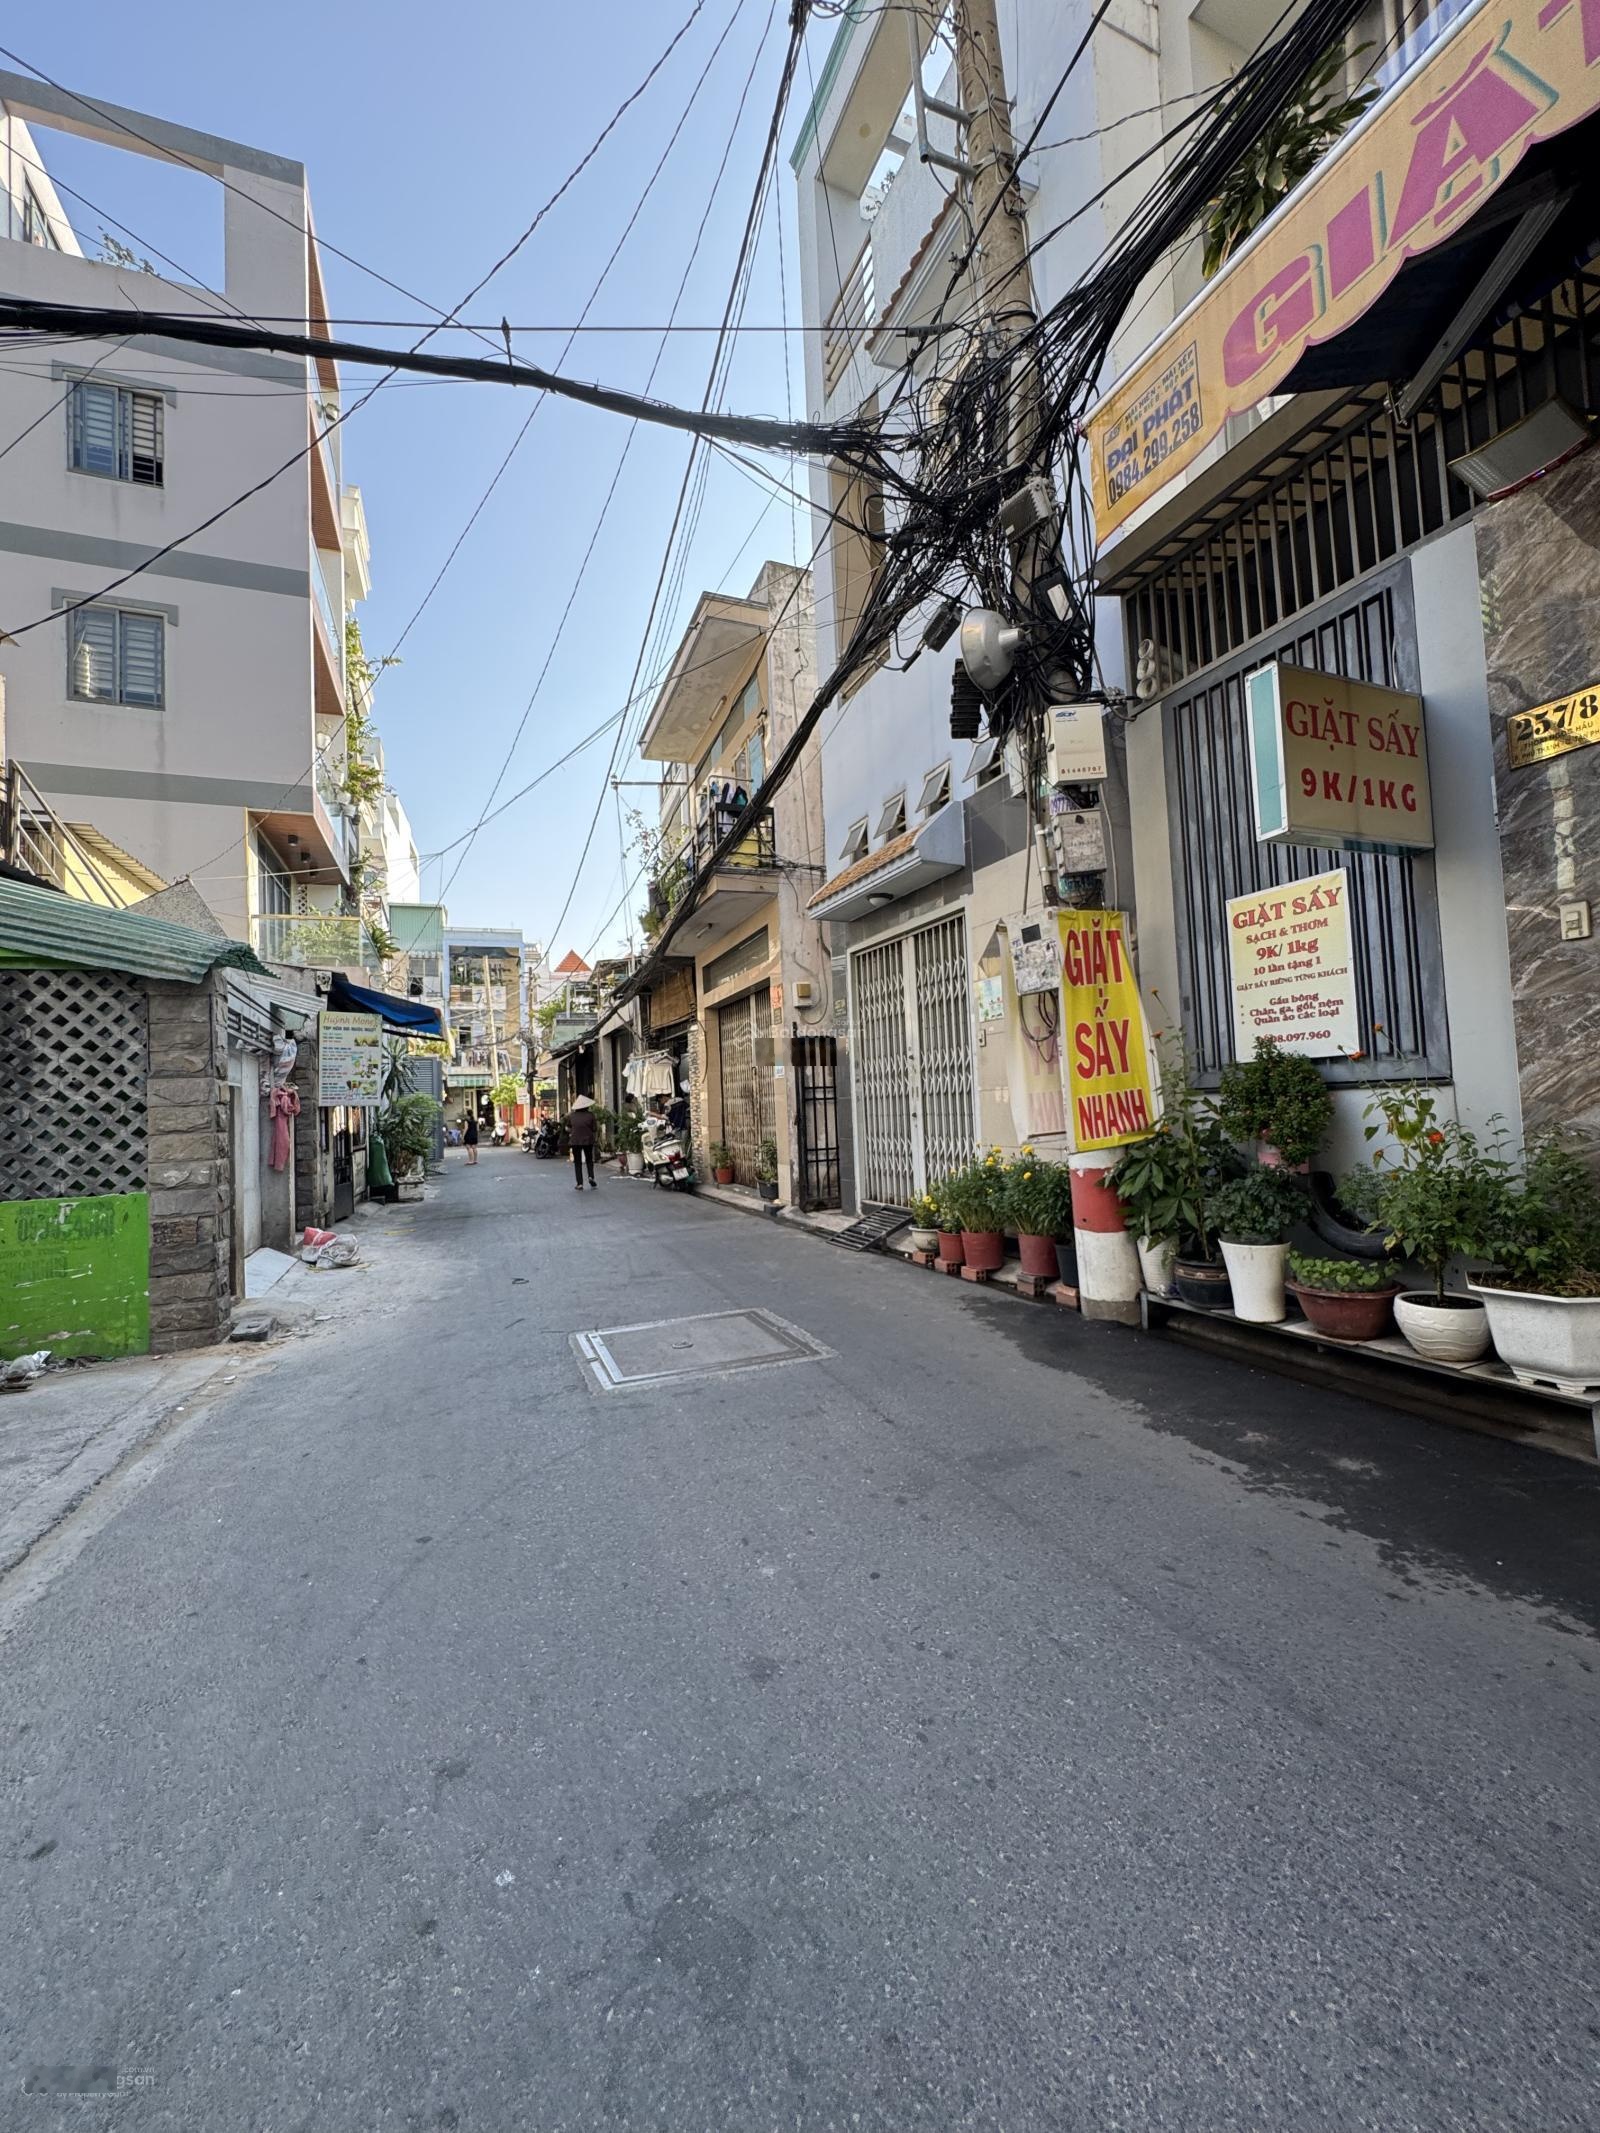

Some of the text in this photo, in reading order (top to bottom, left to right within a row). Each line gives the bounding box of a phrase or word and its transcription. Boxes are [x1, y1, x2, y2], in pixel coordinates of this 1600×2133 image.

[1107, 429, 1139, 473] ĐẠI
[1107, 402, 1201, 505] 0984.299.258
[1285, 697, 1420, 758] GIẶT SẤY
[1516, 694, 1599, 740] 257/8
[1590, 729, 1600, 737] PH
[1232, 885, 1342, 929] GIẶT SẤY
[1246, 917, 1329, 945] SẠCH & THƠM
[1256, 938, 1319, 960] 9K/ 1kg
[1065, 918, 1123, 998] GIẶT
[1254, 966, 1266, 976] 10
[1317, 967, 1348, 978] KHÁCH
[1075, 998, 1130, 1080] SẤY
[1078, 1089, 1149, 1141] NHANH
